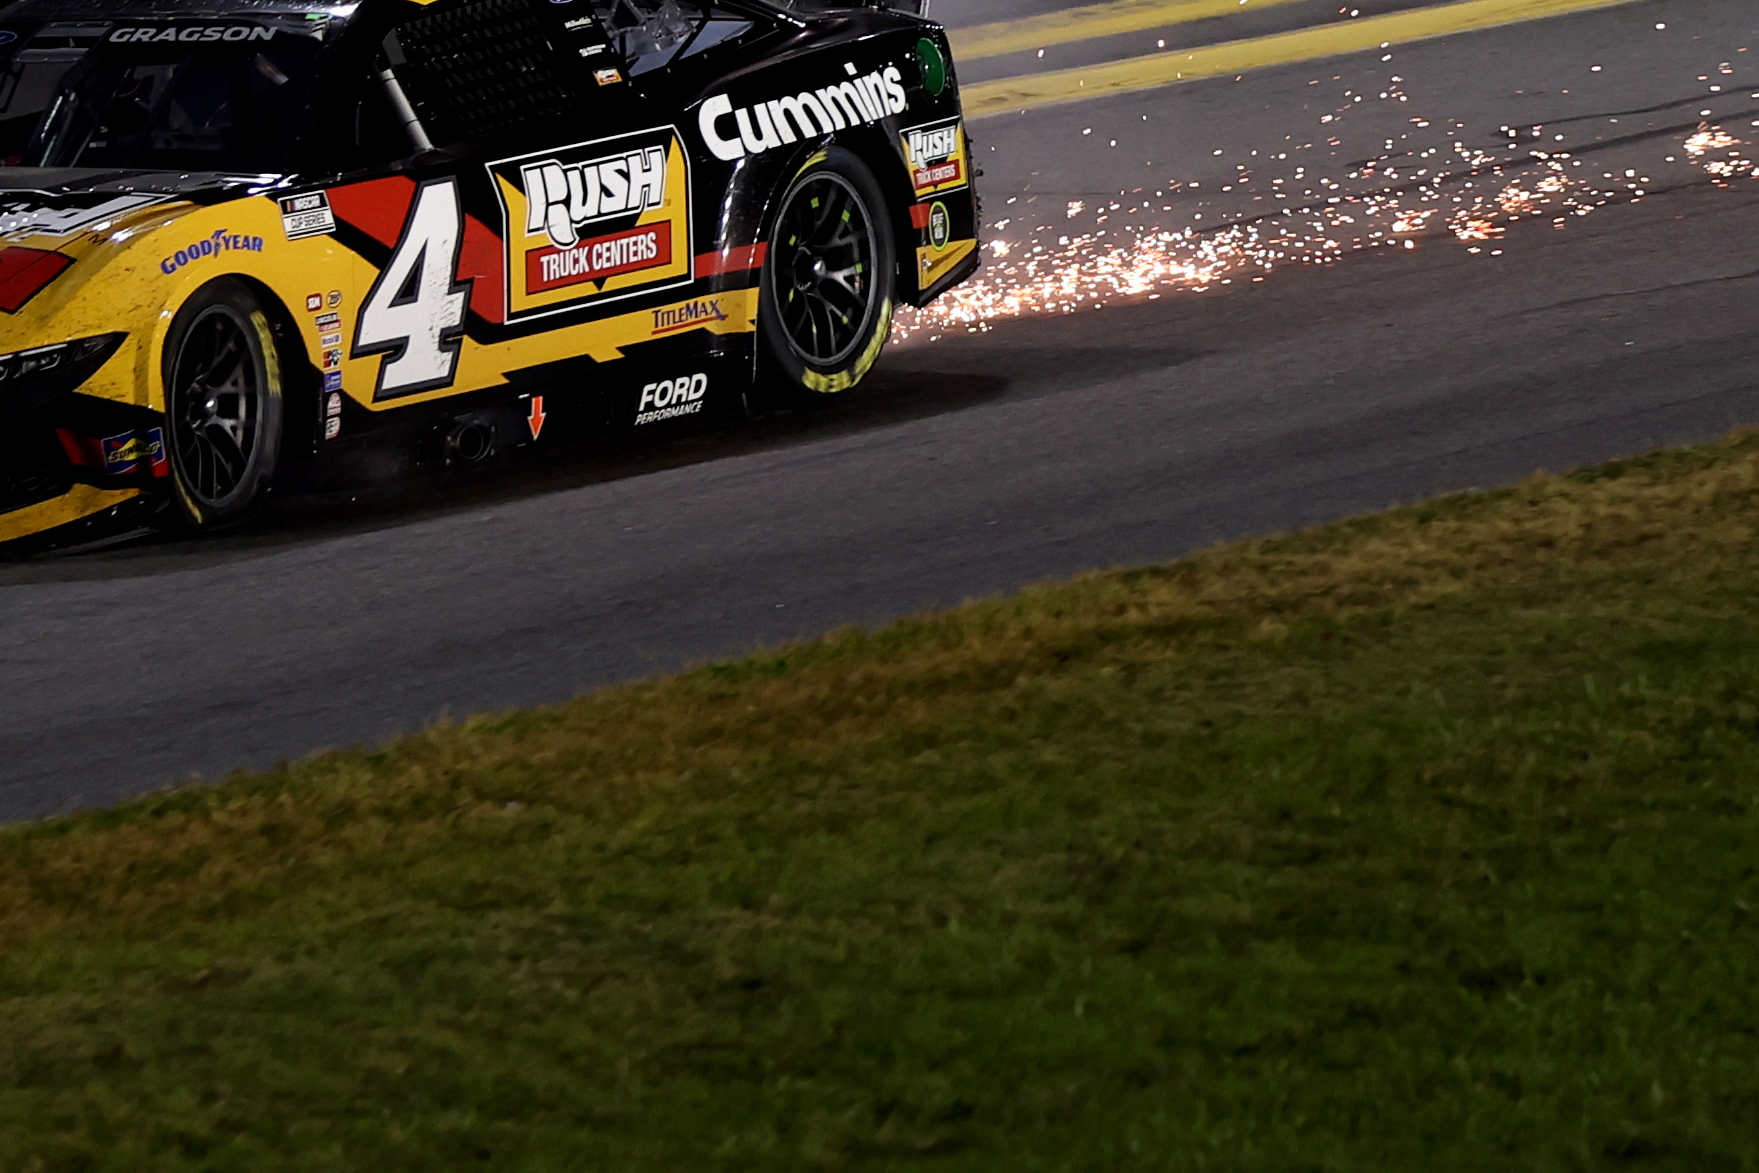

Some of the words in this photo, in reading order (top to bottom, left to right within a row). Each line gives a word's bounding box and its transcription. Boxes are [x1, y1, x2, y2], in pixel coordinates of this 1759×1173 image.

[109, 26, 278, 43] GRAGSON
[698, 61, 907, 161] Cummins
[908, 125, 956, 171] RUSH
[520, 145, 667, 249] RUSH
[160, 229, 264, 275] GOODYEAR
[540, 245, 590, 282] TRUCK
[592, 231, 658, 270] CENTERS
[353, 177, 470, 398] 4
[634, 400, 703, 426] PERFORMANCE
[638, 372, 708, 412] FORD
